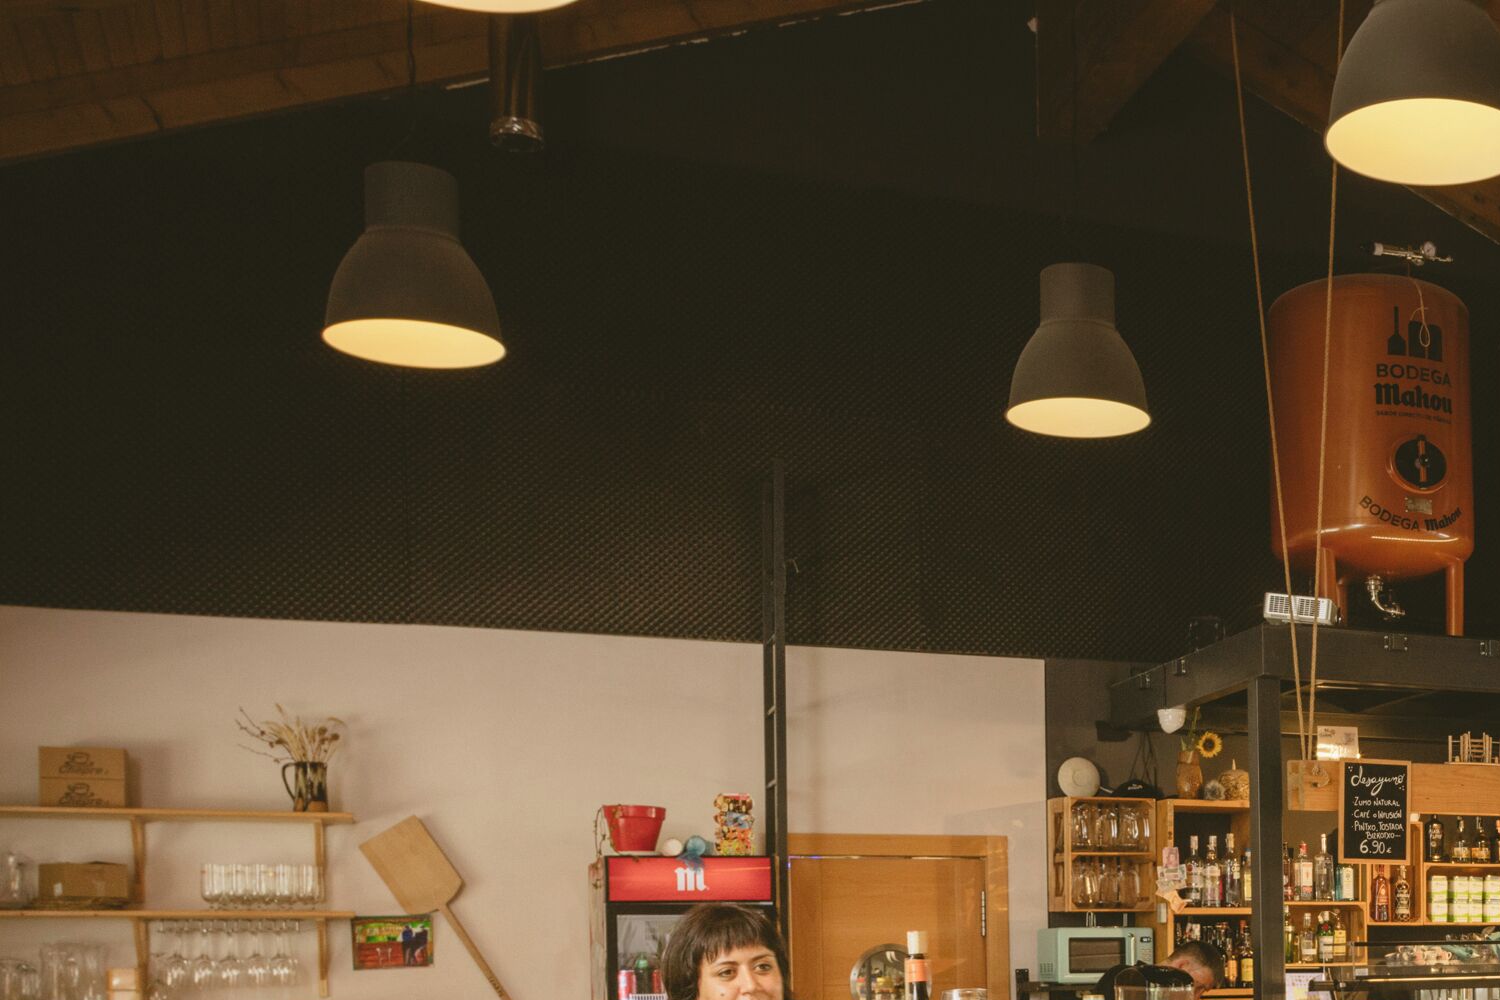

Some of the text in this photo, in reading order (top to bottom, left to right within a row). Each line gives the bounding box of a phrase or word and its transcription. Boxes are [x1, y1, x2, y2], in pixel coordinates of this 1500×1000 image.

[1376, 364, 1451, 386] BODEGA
[1374, 383, 1453, 415] Mahou
[1359, 495, 1462, 531] BODEGA Mahou
[1354, 796, 1400, 807] ZUMO NATURAL
[1353, 809, 1370, 818] CAFÉ
